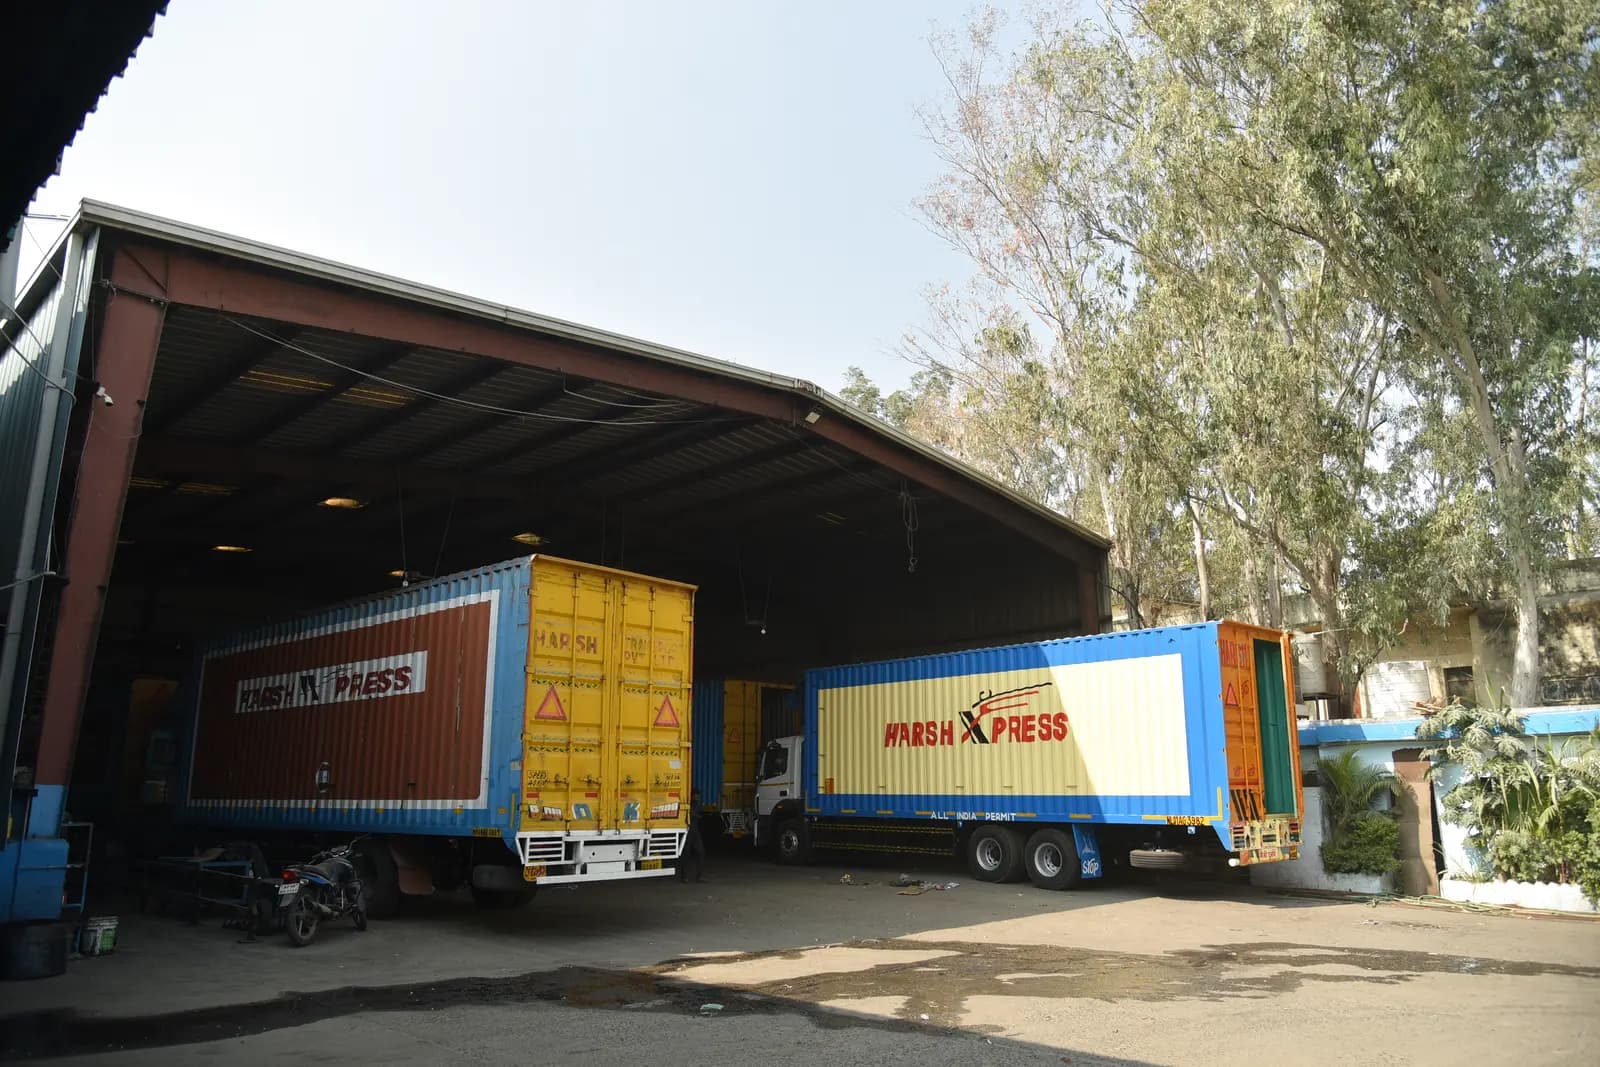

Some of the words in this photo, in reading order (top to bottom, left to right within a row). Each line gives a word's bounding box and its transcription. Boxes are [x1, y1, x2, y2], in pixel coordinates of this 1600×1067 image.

[535, 629, 597, 655] HARSH
[884, 720, 954, 747] HARSH
[930, 811, 949, 820] ALL
[956, 811, 977, 820] INDIA
[985, 812, 1017, 822] PERMIT
